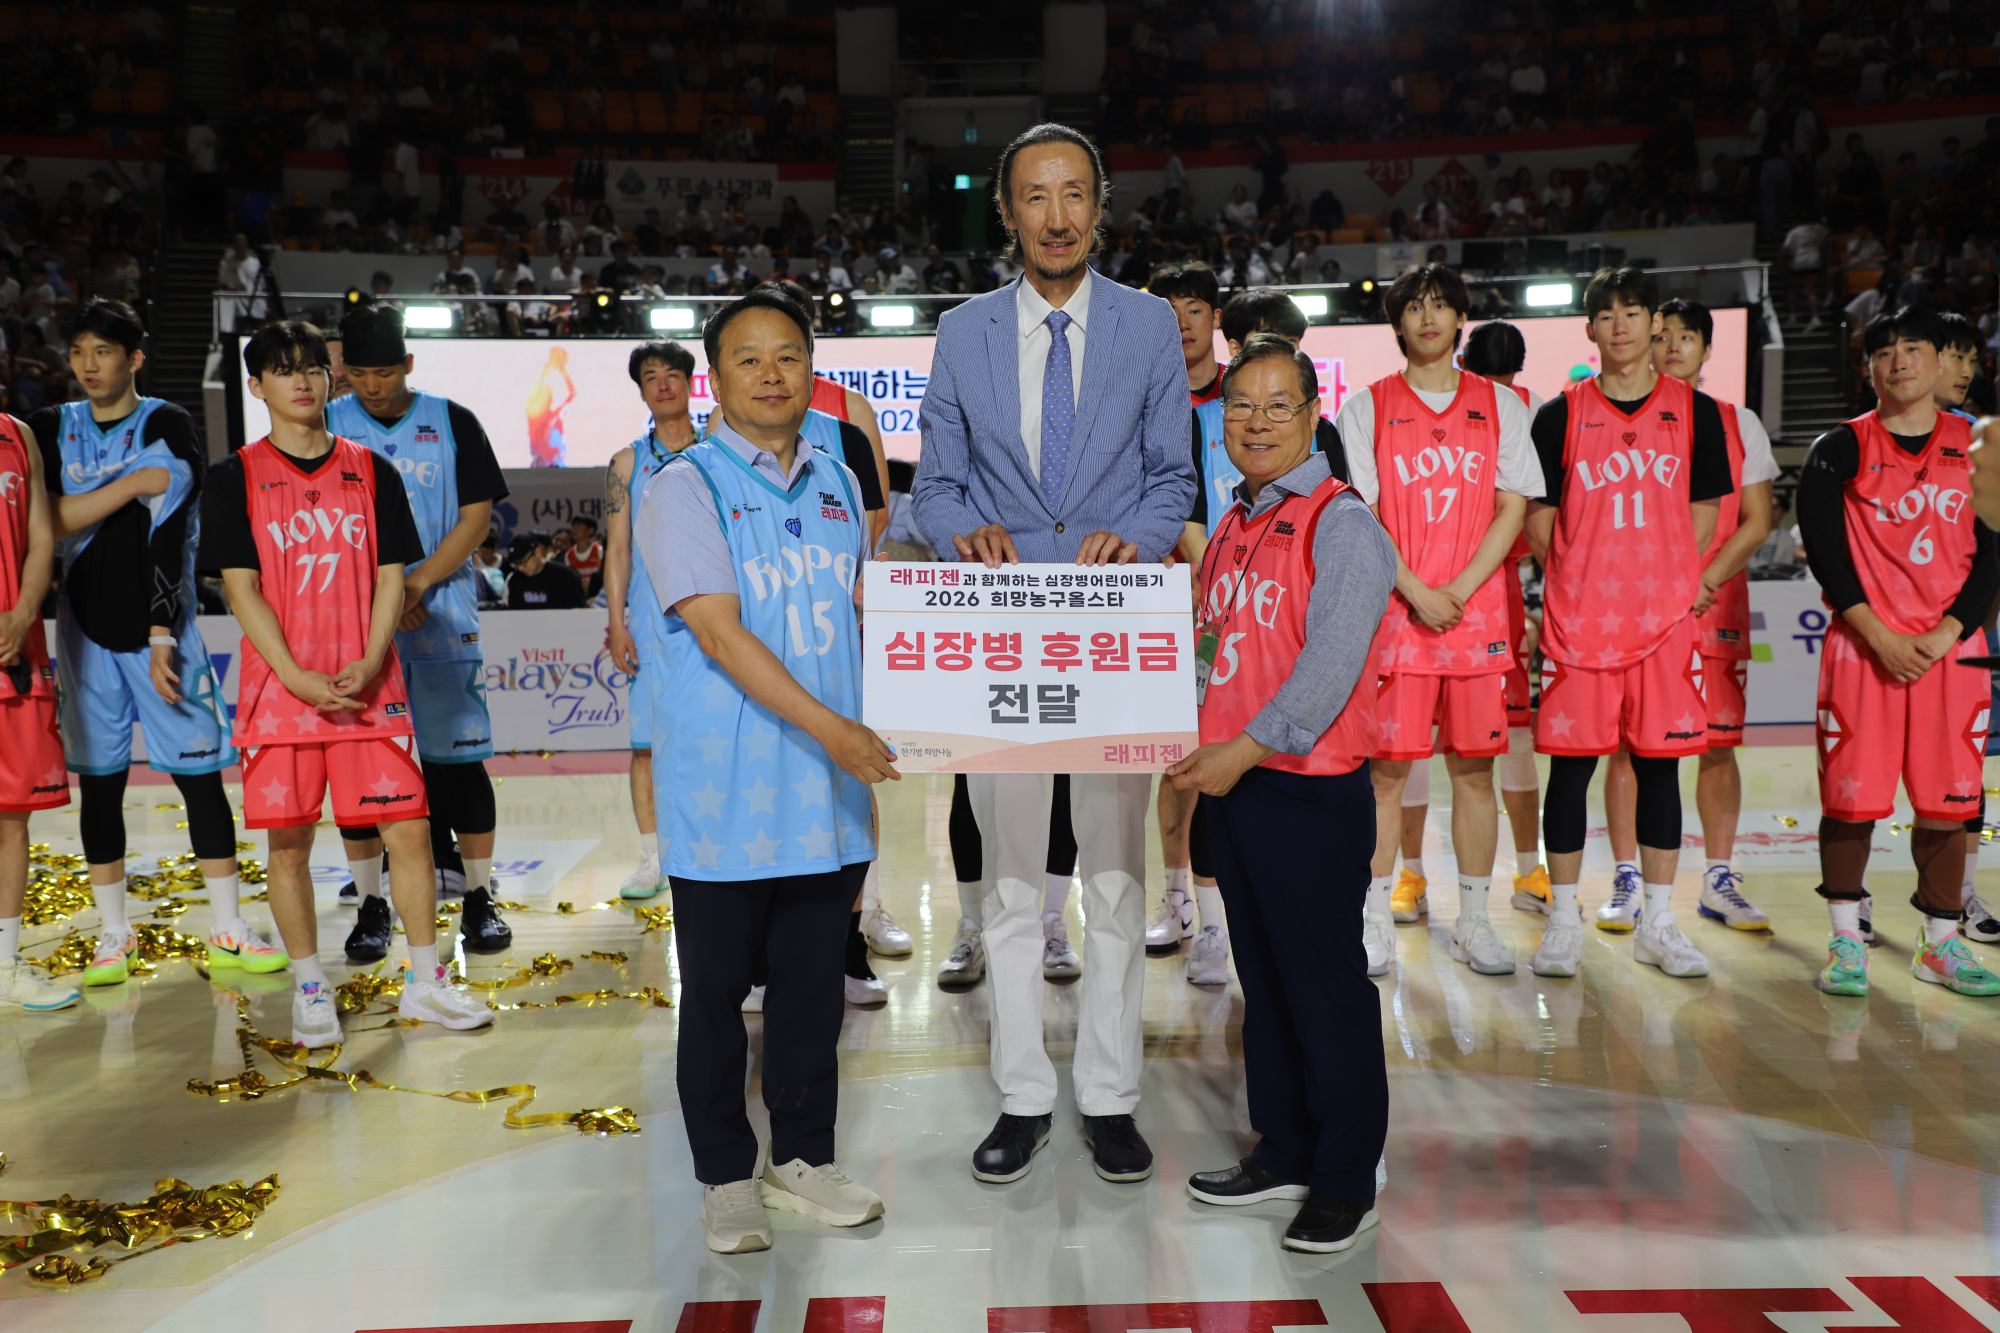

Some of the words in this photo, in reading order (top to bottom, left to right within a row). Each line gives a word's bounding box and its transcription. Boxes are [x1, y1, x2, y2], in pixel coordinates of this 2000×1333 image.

[1373, 160, 1410, 181] 213
[484, 177, 523, 199] 214
[392, 458, 440, 488] PE
[1393, 446, 1486, 486] LOVE
[1576, 449, 1681, 492] LOVE
[819, 492, 834, 501] TEAM
[823, 499, 842, 508] MAKER
[1422, 487, 1458, 524] 17
[1612, 491, 1647, 529] 11
[1869, 483, 1968, 525] LOVE
[532, 498, 573, 524] (사)
[821, 507, 850, 522] 래피젠
[1275, 520, 1294, 528] TEAM
[267, 508, 367, 555] LOVE
[1909, 525, 1934, 565] 6
[296, 552, 341, 596] 77
[890, 568, 978, 588] 래피젠과
[981, 574, 1041, 588] 함께하는
[1045, 574, 1164, 588] 심장병어린이돕기
[925, 591, 980, 607] 2026
[991, 591, 1125, 608] 희망농구올스타
[785, 599, 835, 657] 15
[522, 648, 566, 663] Visit
[885, 631, 1023, 672] 심장병
[1041, 631, 1179, 672] 후원금
[387, 705, 395, 713] XL
[548, 695, 625, 728] Truly
[988, 684, 1080, 724] 전달
[901, 748, 923, 757] 한기범
[924, 748, 953, 757] 희망나눔
[1104, 743, 1183, 764] 래피젠
